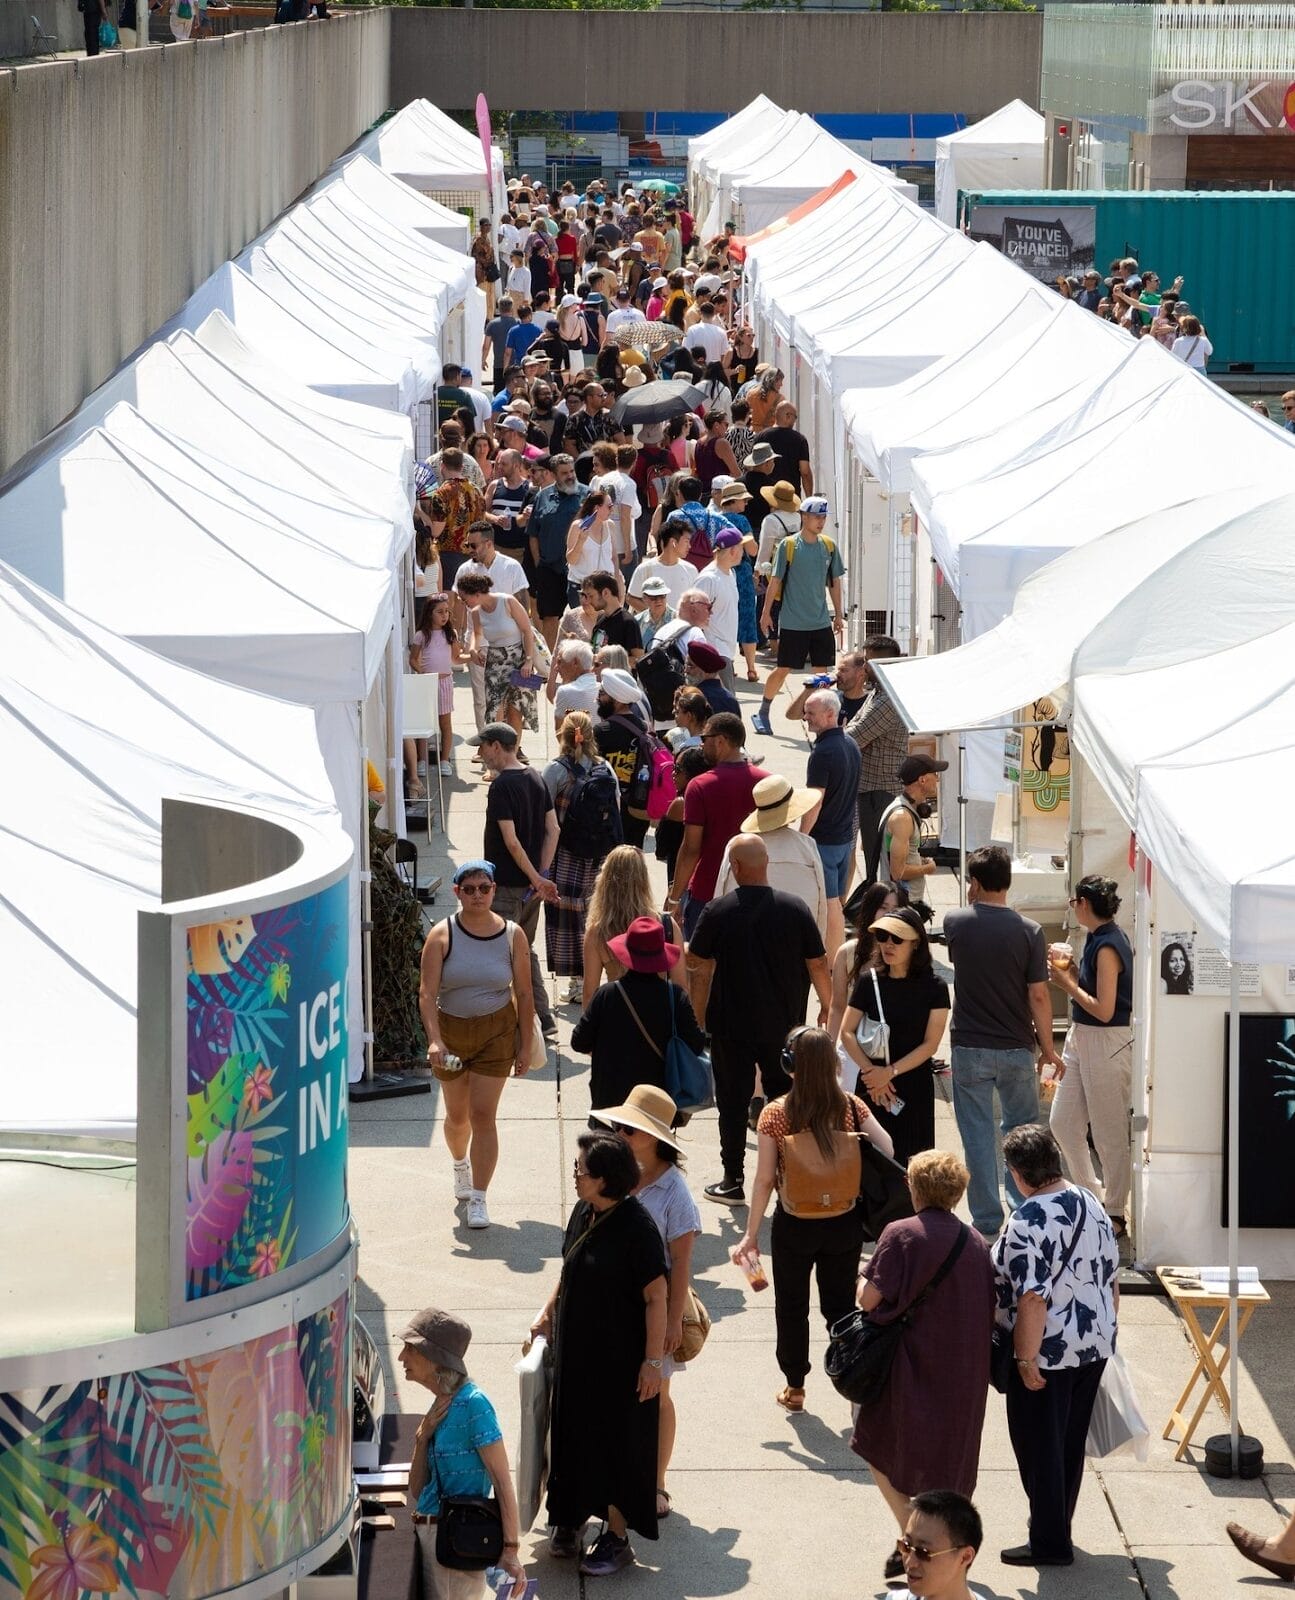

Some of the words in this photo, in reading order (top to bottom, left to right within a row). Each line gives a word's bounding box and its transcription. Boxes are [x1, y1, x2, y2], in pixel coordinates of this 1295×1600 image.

[1169, 80, 1287, 128] SK
[1015, 224, 1061, 242] YOU'VE
[299, 981, 341, 1068] ICE
[299, 1072, 331, 1156] IN
